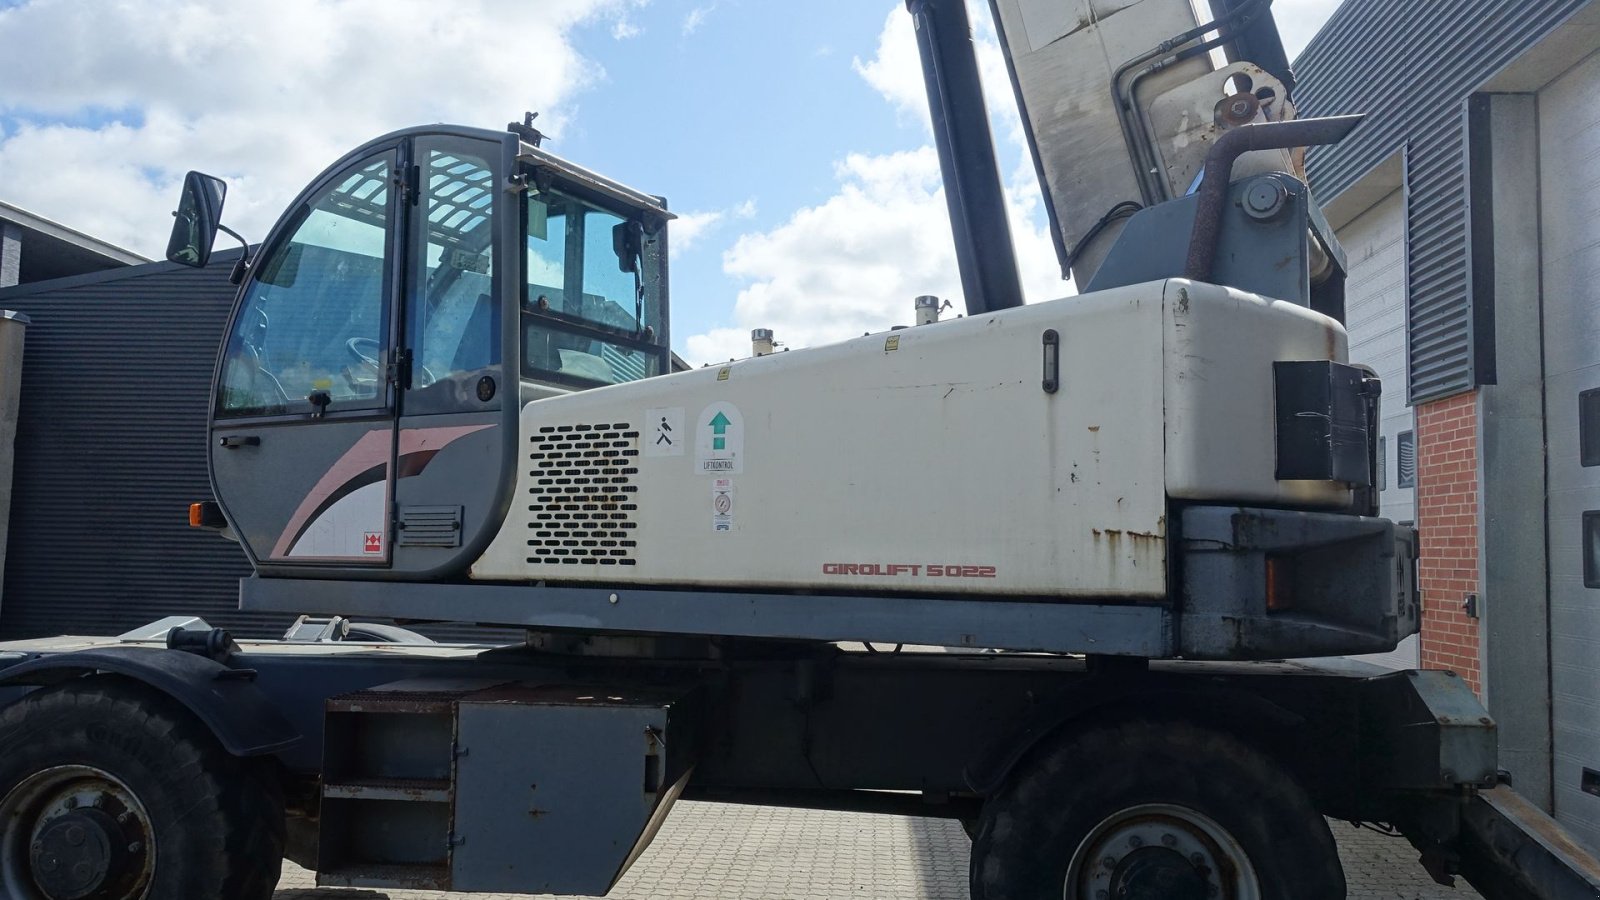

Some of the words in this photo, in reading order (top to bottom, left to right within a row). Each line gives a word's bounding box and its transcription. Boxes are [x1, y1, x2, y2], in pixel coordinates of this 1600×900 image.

[703, 461, 734, 470] LIFTKONTROL
[822, 563, 923, 577] GIROLIFT
[926, 564, 997, 578] 5022
